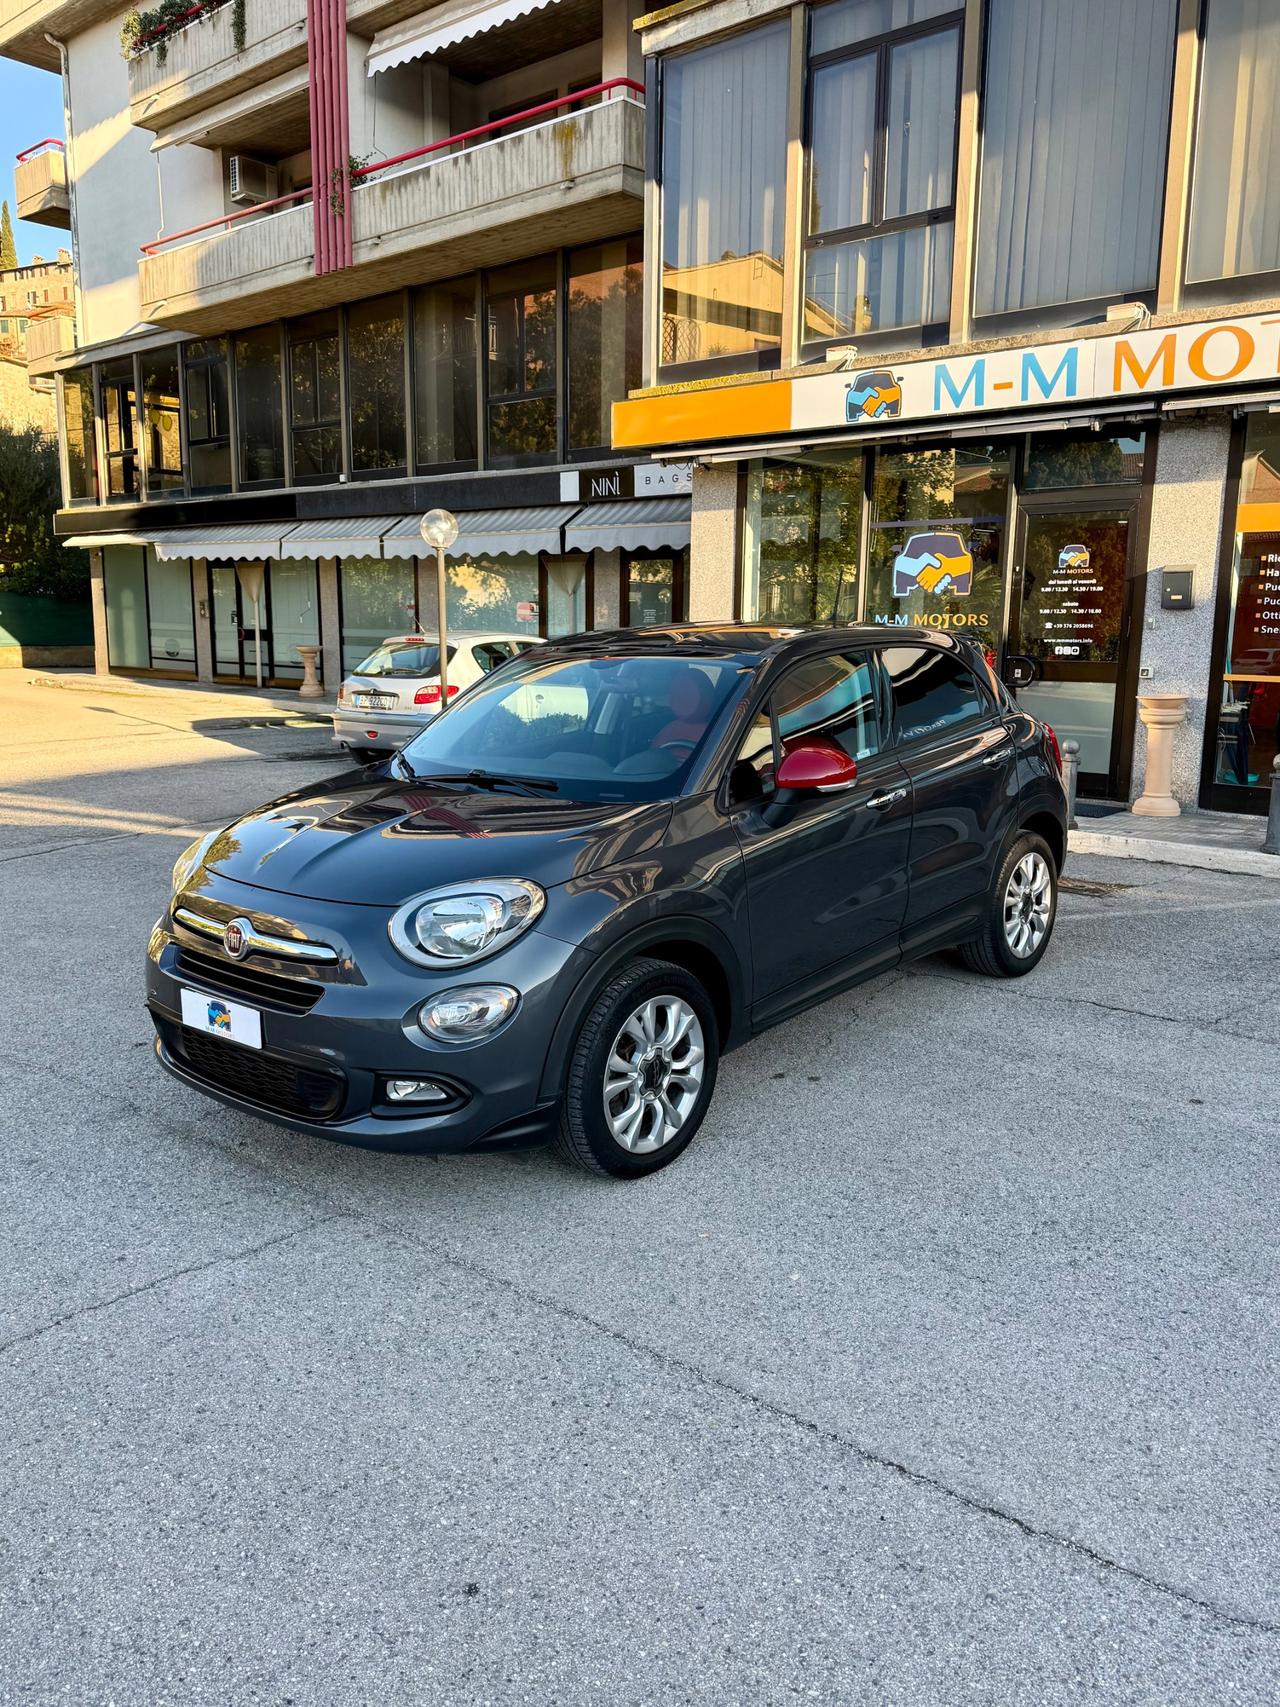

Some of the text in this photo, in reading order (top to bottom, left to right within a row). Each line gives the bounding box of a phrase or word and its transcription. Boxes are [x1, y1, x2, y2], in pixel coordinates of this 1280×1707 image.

[933, 346, 1079, 411] M-M
[591, 471, 620, 497] NINÌ
[645, 473, 692, 485] BAGS
[875, 613, 989, 626] M-M MOTORS
[228, 932, 241, 949] FIAT
